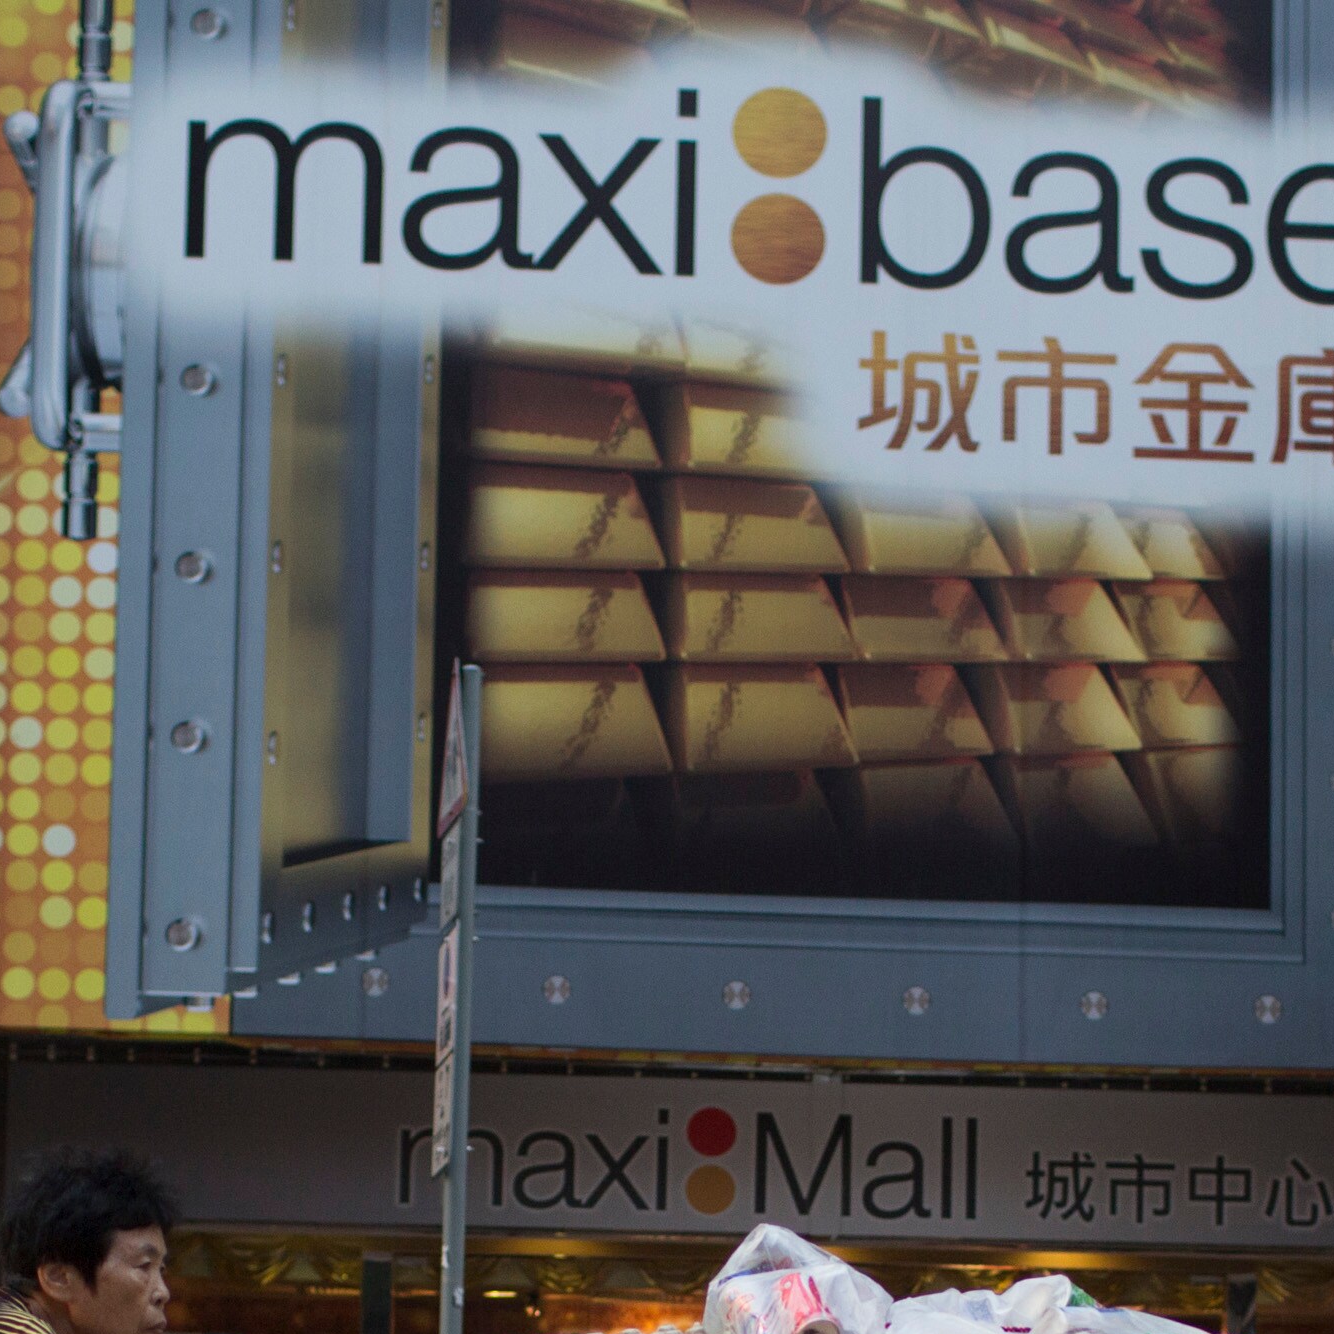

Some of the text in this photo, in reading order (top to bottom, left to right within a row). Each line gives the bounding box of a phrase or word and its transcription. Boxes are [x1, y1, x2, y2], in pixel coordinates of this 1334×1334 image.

[184, 87, 698, 278] maxi
[398, 1107, 670, 1212] maxi
[754, 1111, 979, 1220] Mall
[1024, 1151, 1334, 1229] 城市中心
